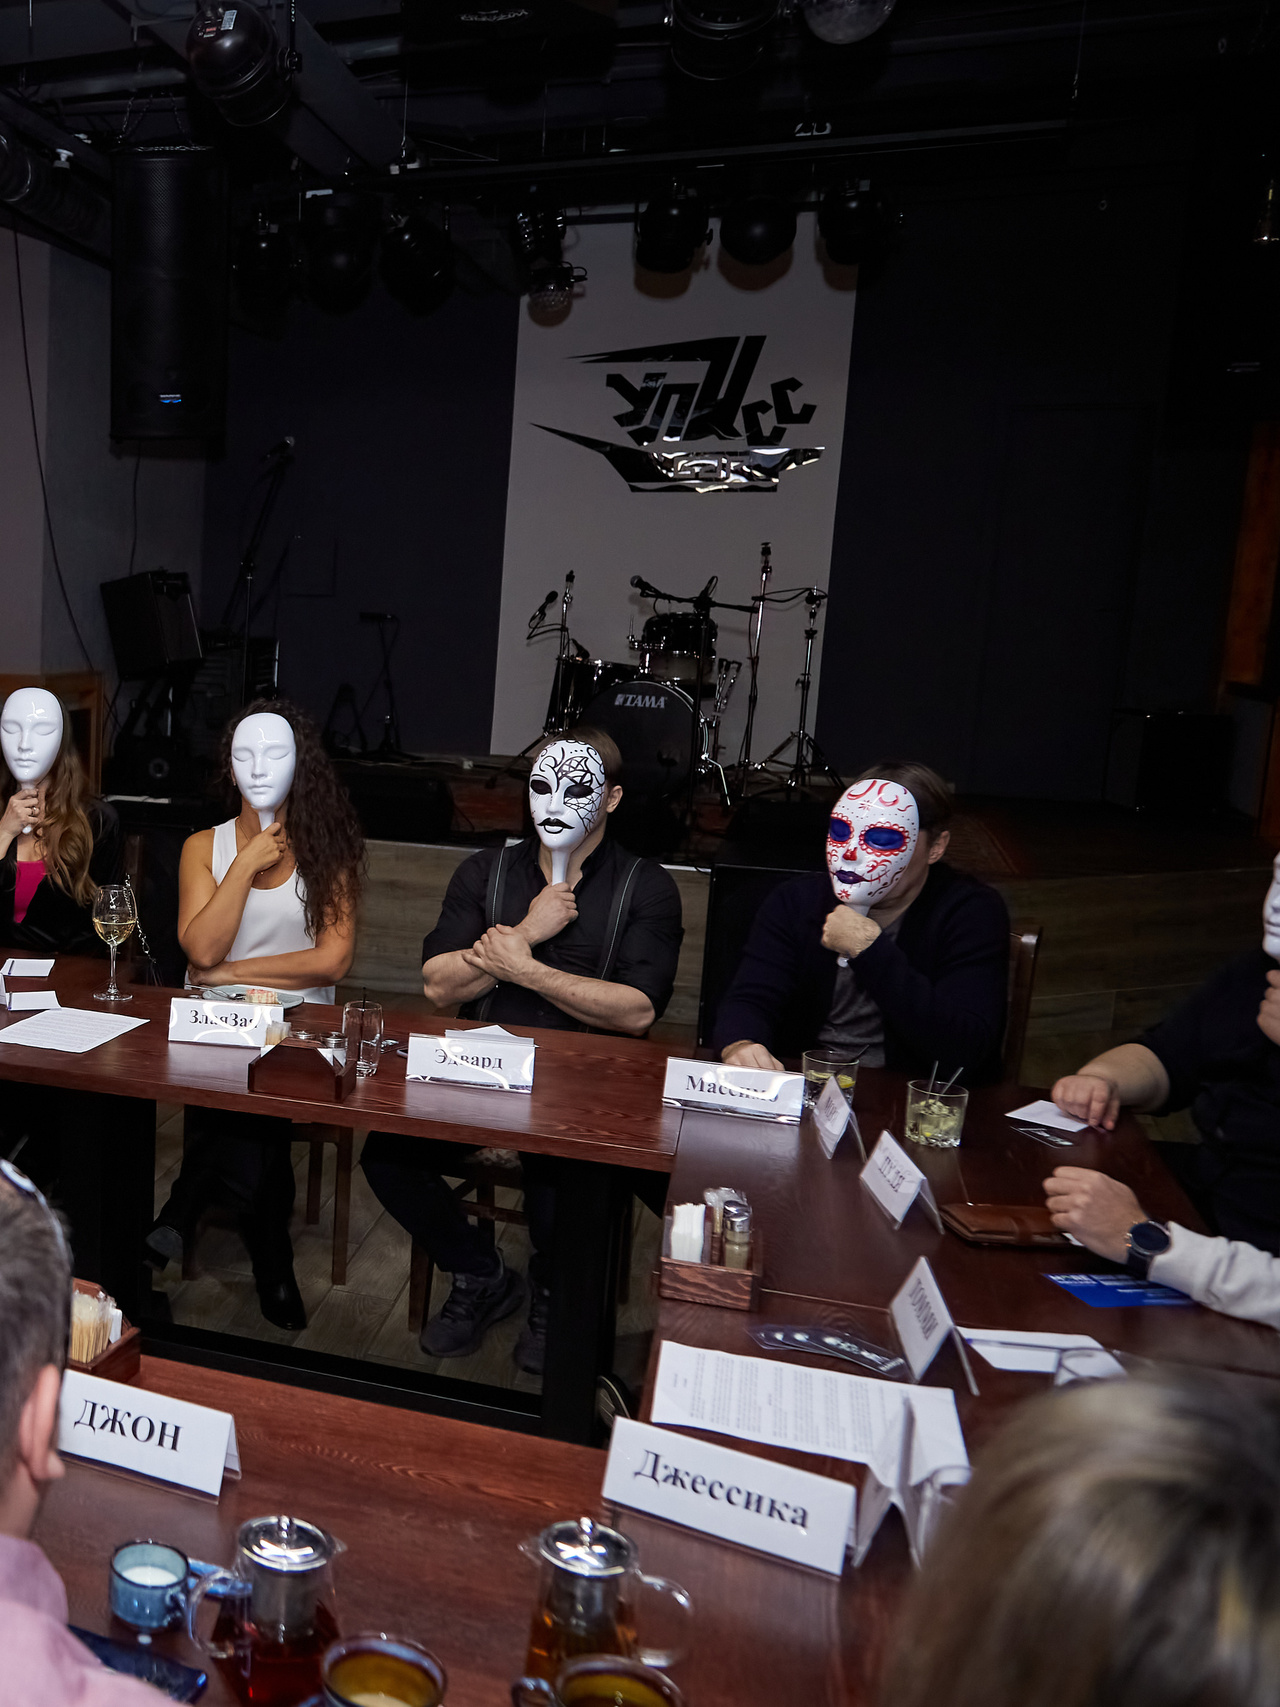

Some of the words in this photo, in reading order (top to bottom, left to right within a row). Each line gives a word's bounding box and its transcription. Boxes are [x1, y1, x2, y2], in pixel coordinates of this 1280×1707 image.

[623, 693, 665, 709] TAMA
[434, 1048, 503, 1070] Эдвард
[73, 1398, 183, 1452] ДЖОН
[633, 1449, 810, 1529] Джессика
